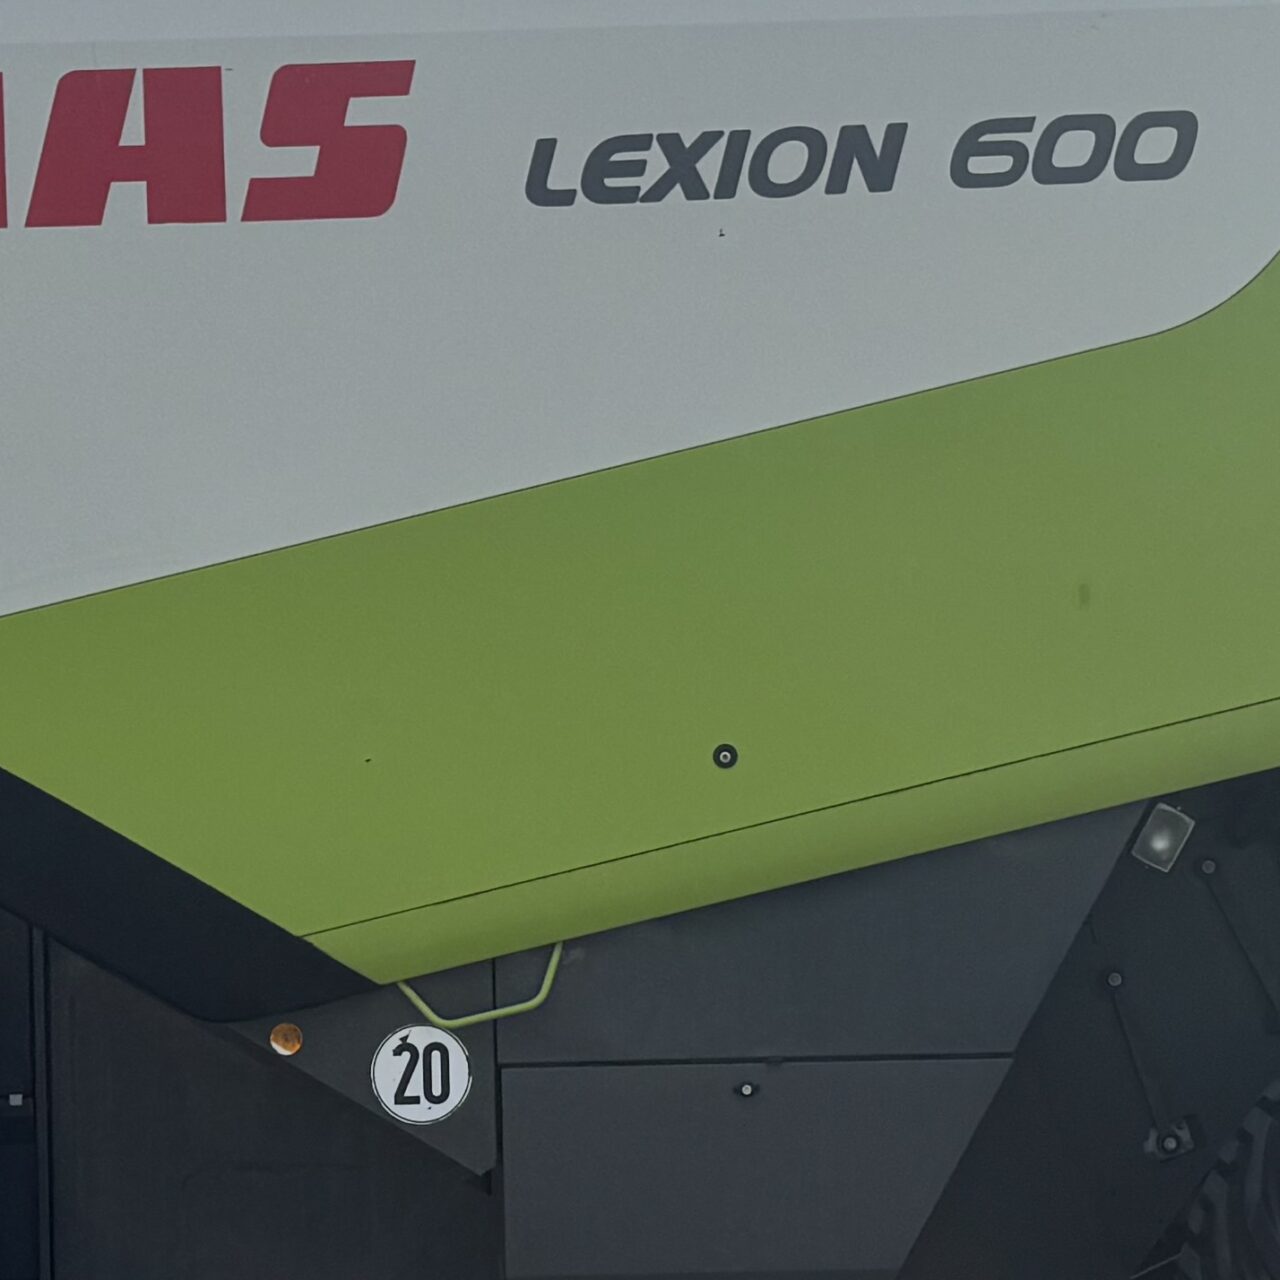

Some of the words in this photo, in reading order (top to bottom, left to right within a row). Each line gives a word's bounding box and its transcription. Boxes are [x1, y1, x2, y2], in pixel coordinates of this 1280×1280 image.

[524, 121, 909, 207] LEXION
[949, 109, 1199, 189] 600
[392, 1040, 451, 1106] 20
